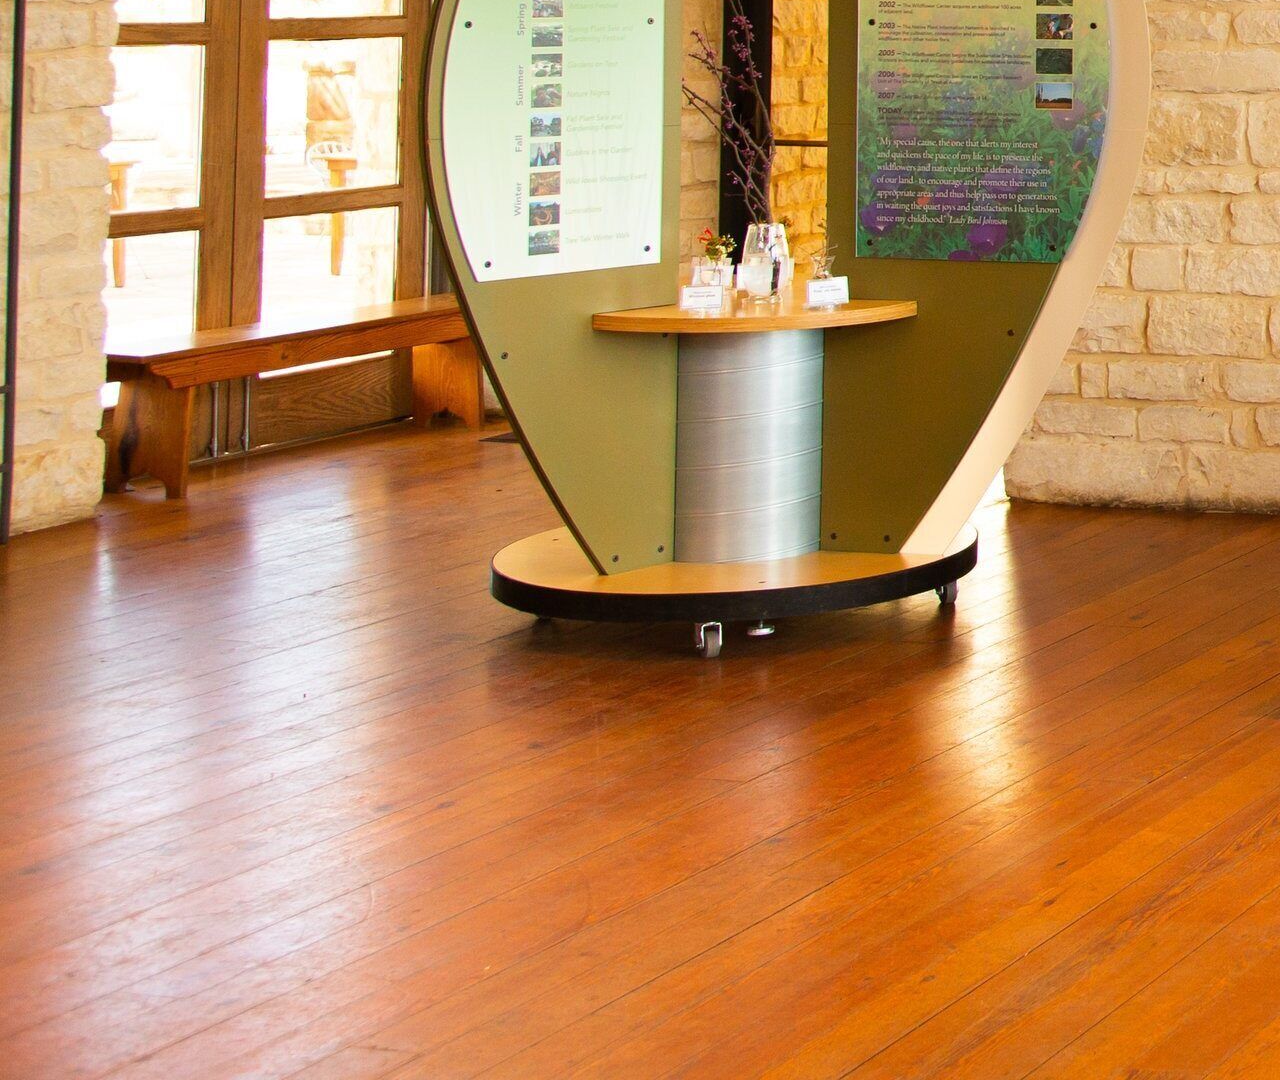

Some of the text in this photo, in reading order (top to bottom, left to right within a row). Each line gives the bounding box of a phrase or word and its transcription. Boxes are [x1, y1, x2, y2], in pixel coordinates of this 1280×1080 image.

[517, 3, 528, 36] Spring
[516, 65, 524, 106] Summer
[515, 135, 523, 153] Fall
[892, 137, 916, 148] special
[938, 138, 950, 147] the
[965, 138, 979, 147] that
[980, 139, 999, 148] alerts
[1000, 142, 1013, 150] my
[1013, 139, 1038, 149] interest
[876, 149, 890, 158] and
[891, 150, 922, 160] quickens
[923, 151, 934, 159] the
[935, 153, 952, 162] pace
[952, 151, 961, 159] of
[960, 154, 971, 162] my
[1001, 154, 1031, 163] preserve
[1032, 153, 1044, 162] the
[877, 163, 916, 171] wildflowers
[917, 163, 931, 172] and
[953, 164, 974, 175] plants
[989, 166, 1011, 174] define
[1013, 165, 1024, 174] the
[1025, 167, 1051, 177] regions
[876, 175, 885, 184] of
[898, 176, 914, 184] land
[926, 179, 963, 189] encourage
[963, 177, 977, 186] and
[978, 179, 1009, 188] promote
[1009, 178, 1026, 187] their
[514, 182, 522, 217] Winter
[876, 190, 916, 199] appropriate
[935, 189, 949, 198] and
[949, 190, 964, 198] thus
[965, 190, 981, 201] help
[982, 193, 997, 201] pass
[1017, 194, 1058, 203] generations
[884, 202, 910, 212] waiting
[911, 202, 921, 210] the
[922, 203, 941, 213] quiet
[941, 204, 956, 213] joys
[957, 203, 971, 211] and
[971, 203, 1013, 212] satisfactions
[1018, 204, 1035, 213] have
[1035, 204, 1061, 214] known
[895, 216, 907, 225] my
[967, 216, 982, 225] Bird
[982, 217, 1008, 225] Johnson
